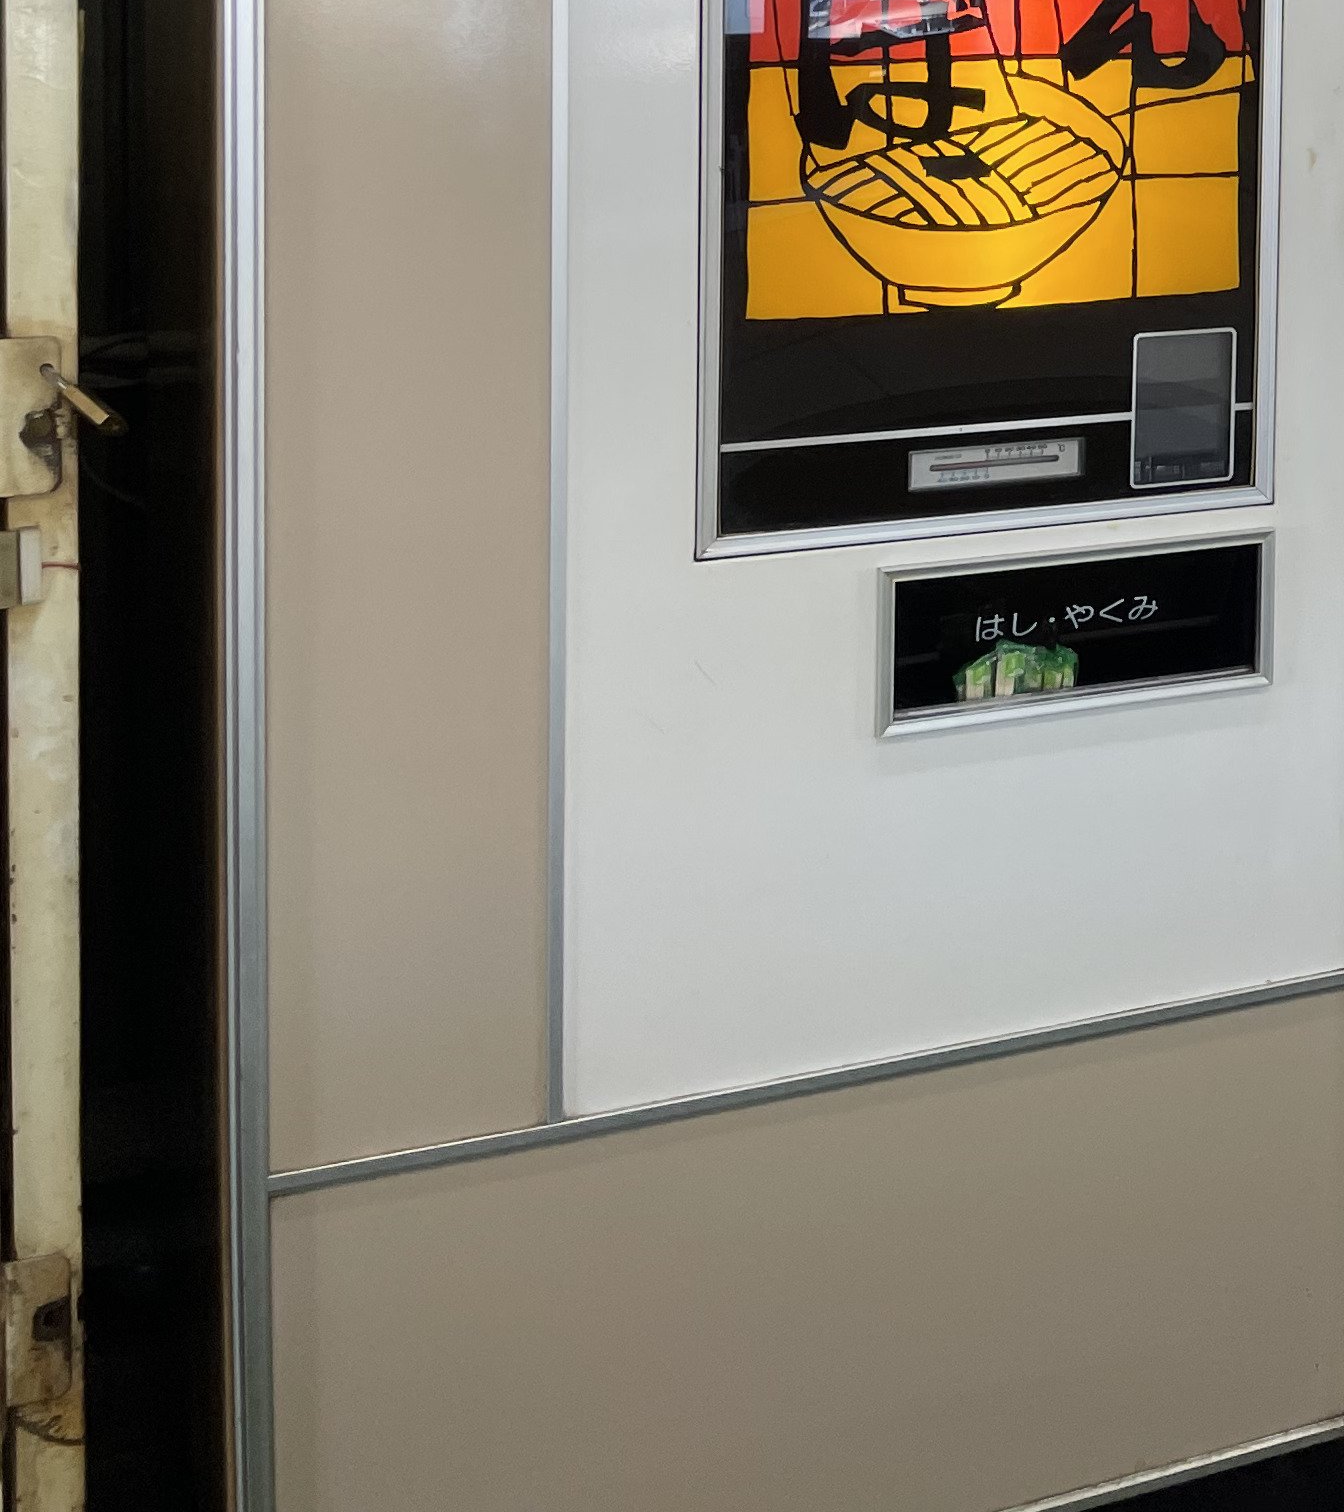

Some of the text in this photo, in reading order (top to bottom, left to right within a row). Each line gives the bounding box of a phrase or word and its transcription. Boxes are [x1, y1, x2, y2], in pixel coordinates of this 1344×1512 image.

[975, 594, 1159, 643] はし・やくみ
